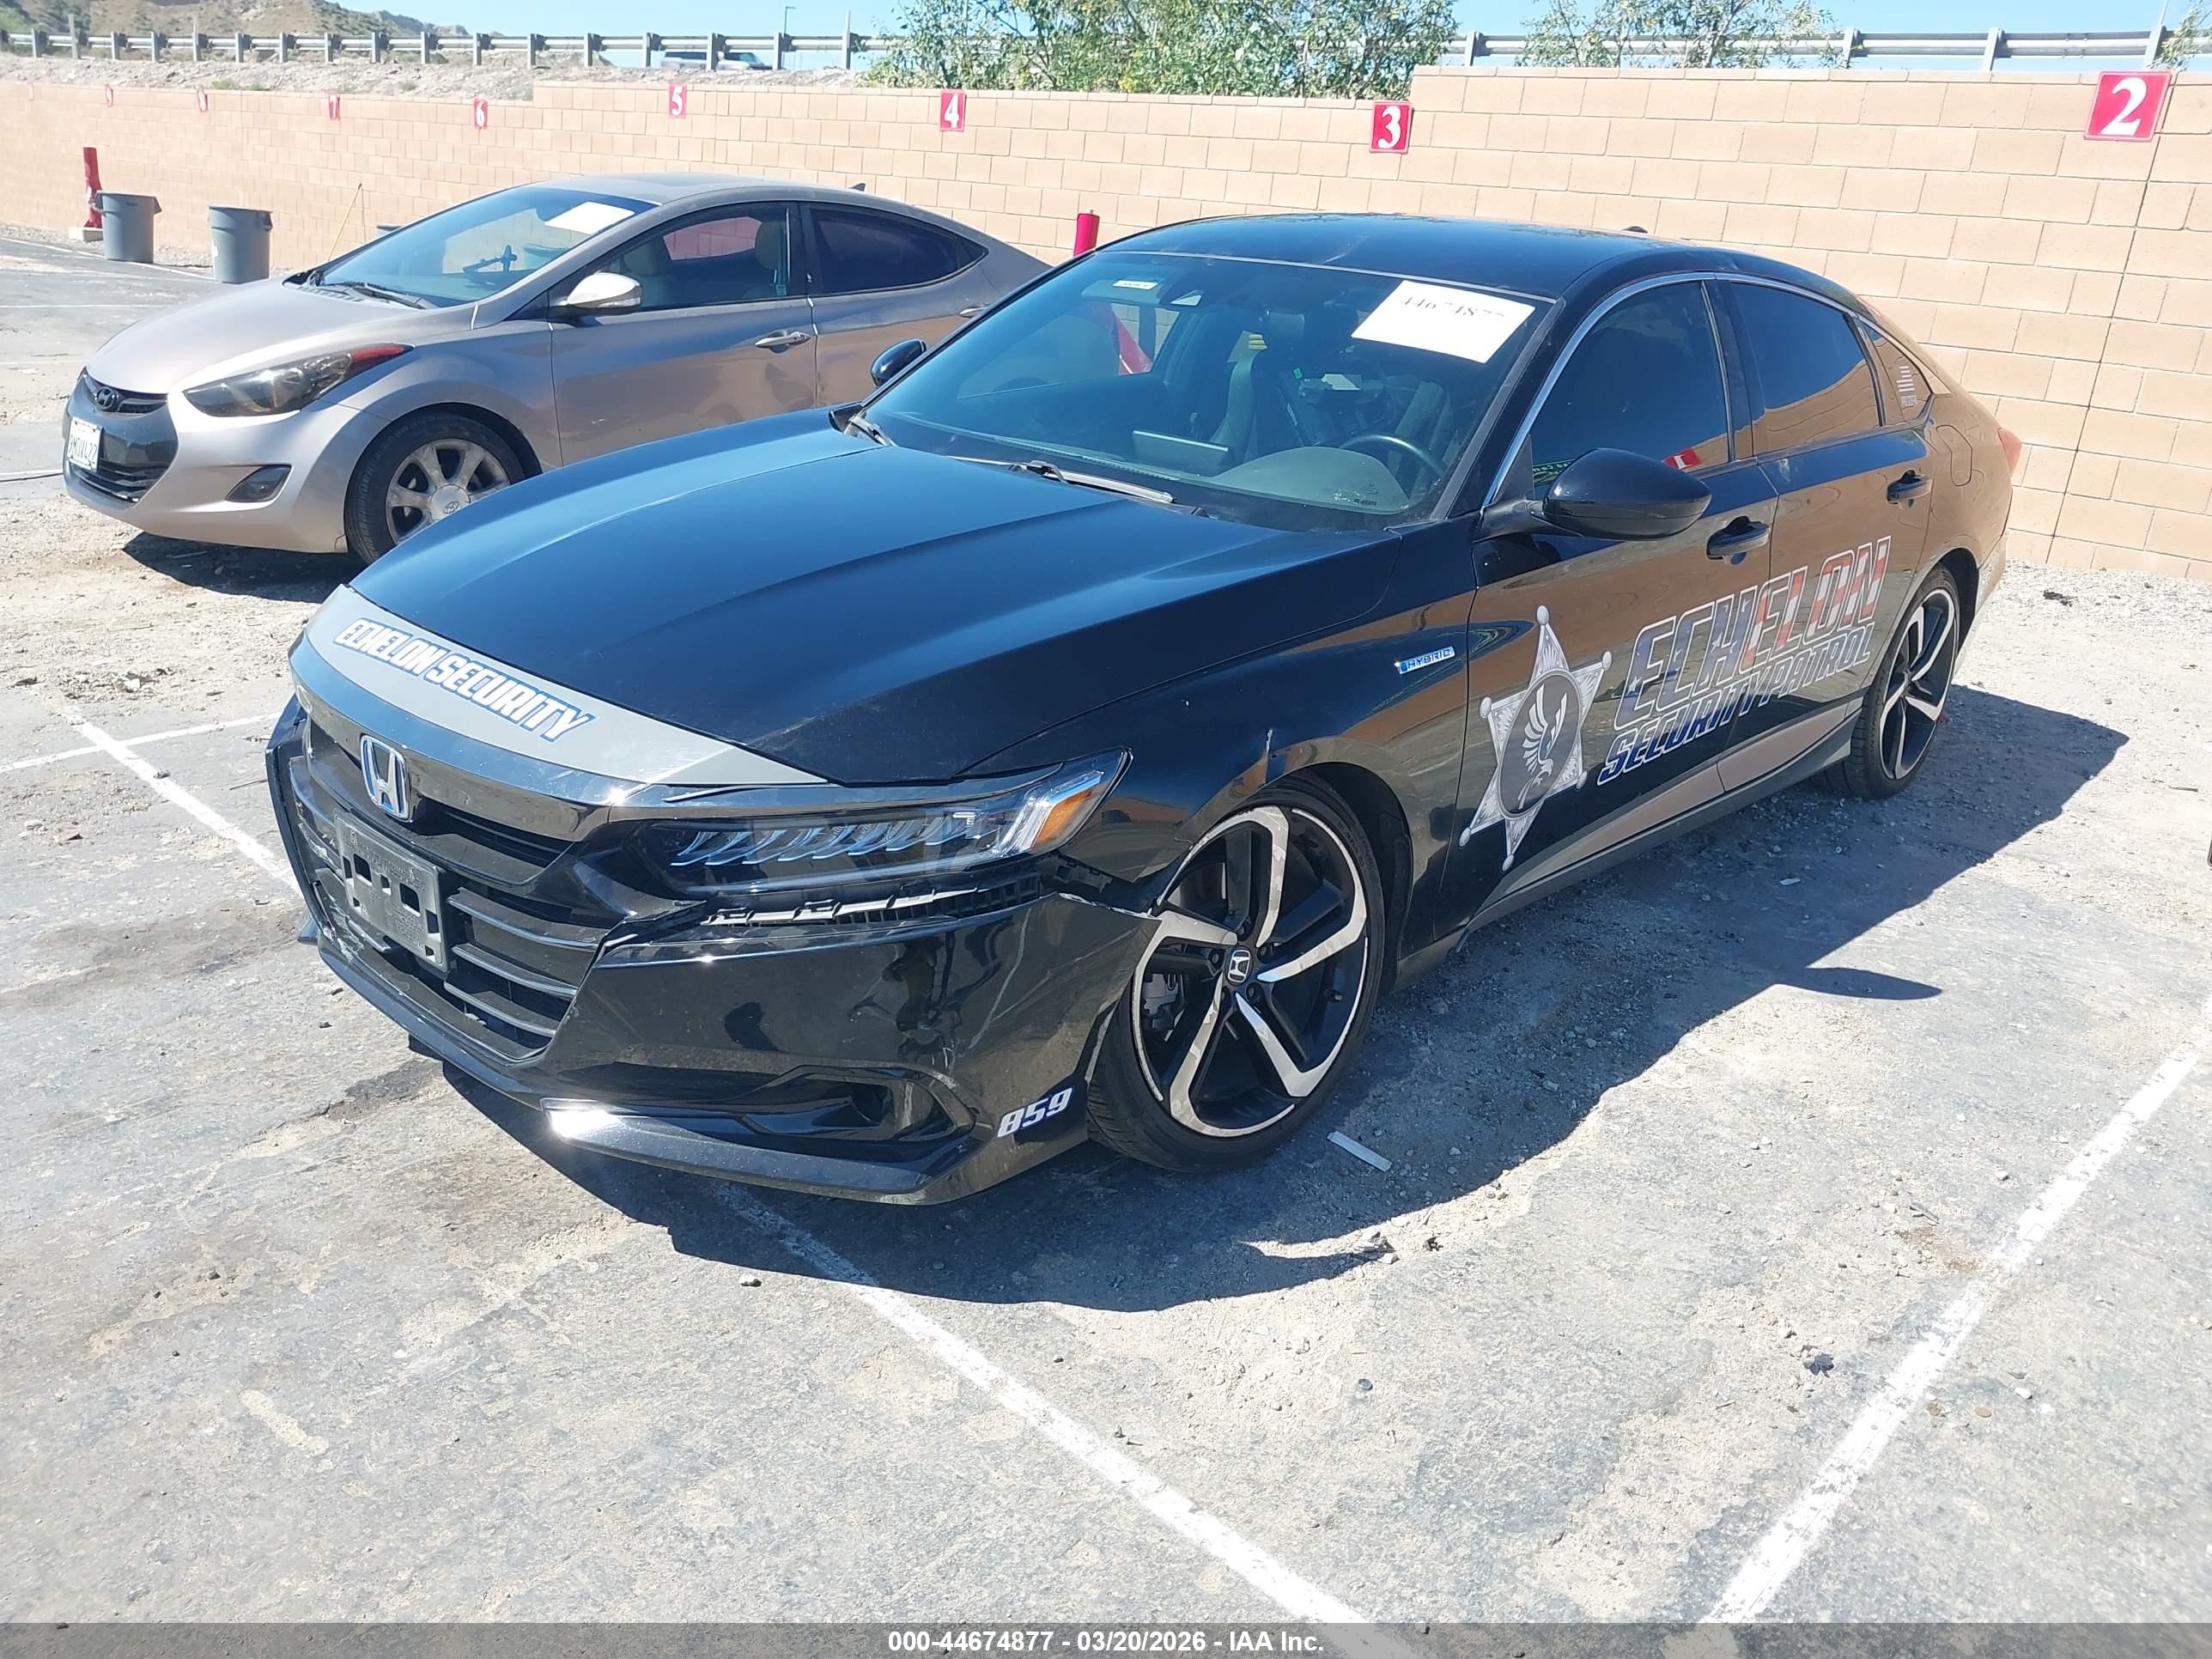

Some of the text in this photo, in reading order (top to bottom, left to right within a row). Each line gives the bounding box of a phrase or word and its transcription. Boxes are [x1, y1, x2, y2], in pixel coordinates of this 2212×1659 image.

[475, 100, 486, 128] 6
[672, 85, 683, 116] 5
[945, 93, 960, 129] 4
[2100, 76, 2148, 137] 2
[1376, 105, 1402, 149] 3
[1614, 536, 1892, 730] ECHELON
[332, 617, 597, 743] ECHELON SECURITY
[1407, 648, 1451, 669] HYBRID
[997, 1086, 1073, 1138] 859
